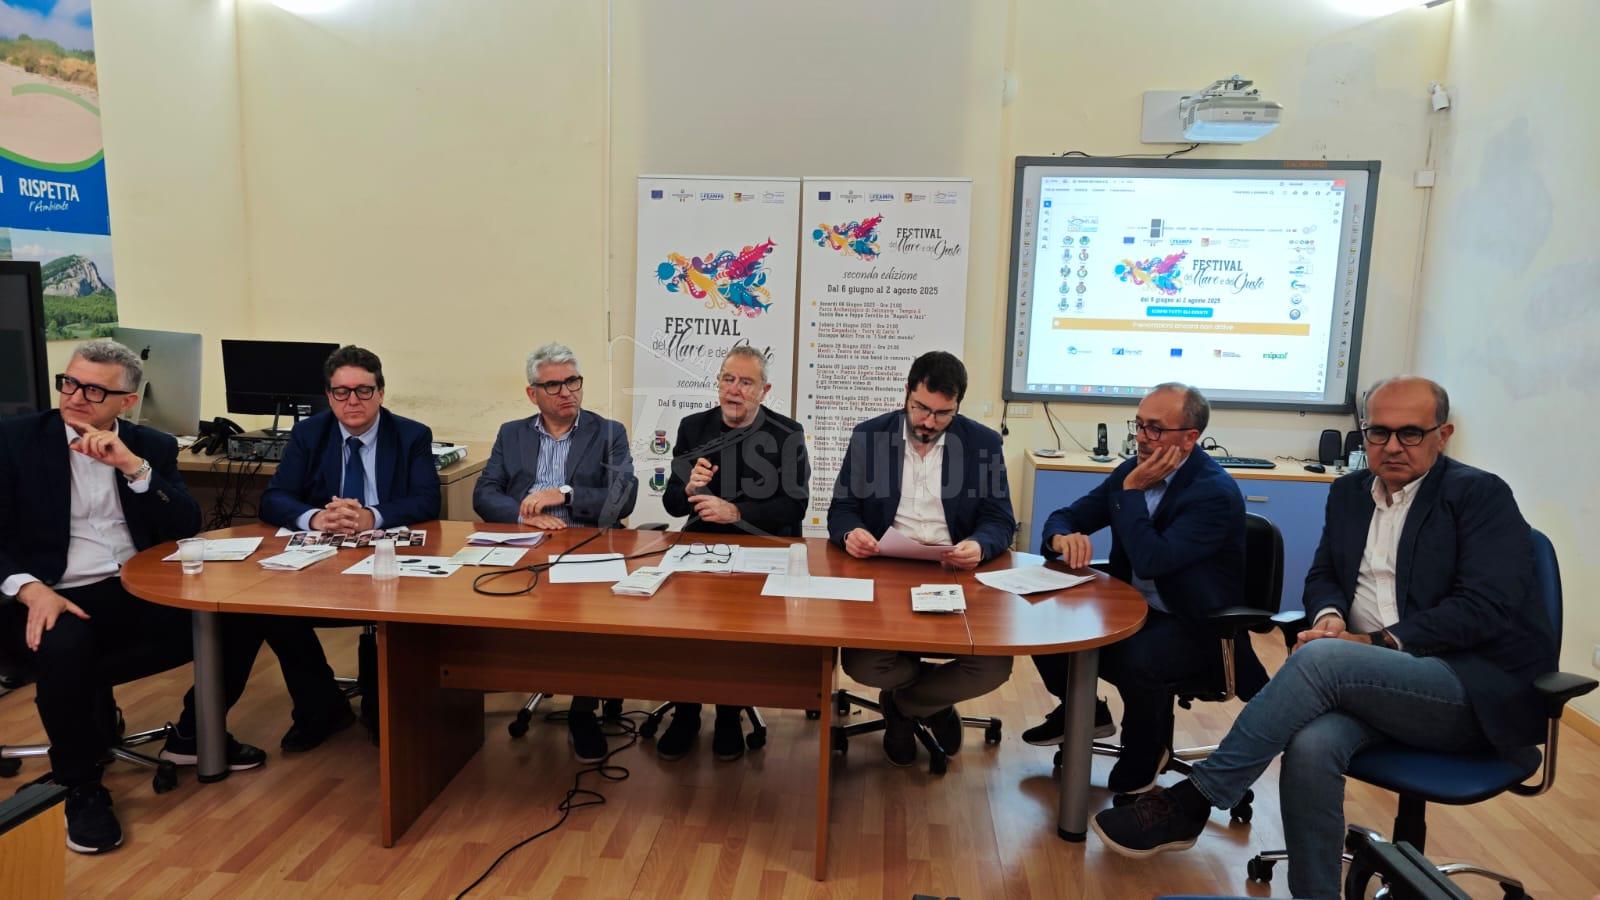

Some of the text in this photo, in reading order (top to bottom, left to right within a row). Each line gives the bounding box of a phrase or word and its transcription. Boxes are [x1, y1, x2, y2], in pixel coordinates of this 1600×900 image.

[18, 178, 80, 202] RISPETTA
[897, 228, 942, 239] FESTIVAL
[897, 238, 921, 255] Mare
[934, 240, 961, 260] Gusto
[842, 266, 918, 280] seconda edizione
[1193, 260, 1243, 272] FESTIVAL
[1194, 268, 1220, 288] Mare
[1232, 272, 1265, 294] Gusto
[827, 284, 839, 293] Dal
[842, 285, 846, 293] 6
[848, 286, 874, 295] giugno
[886, 286, 890, 294] 2
[893, 287, 917, 296] agosto
[919, 286, 938, 295] 2025
[665, 317, 740, 336] FESTIVAL
[653, 340, 666, 350] del
[668, 332, 704, 361] Mare
[676, 376, 710, 388] seconda
[658, 399, 669, 407] Dal
[679, 400, 703, 409] giugno
